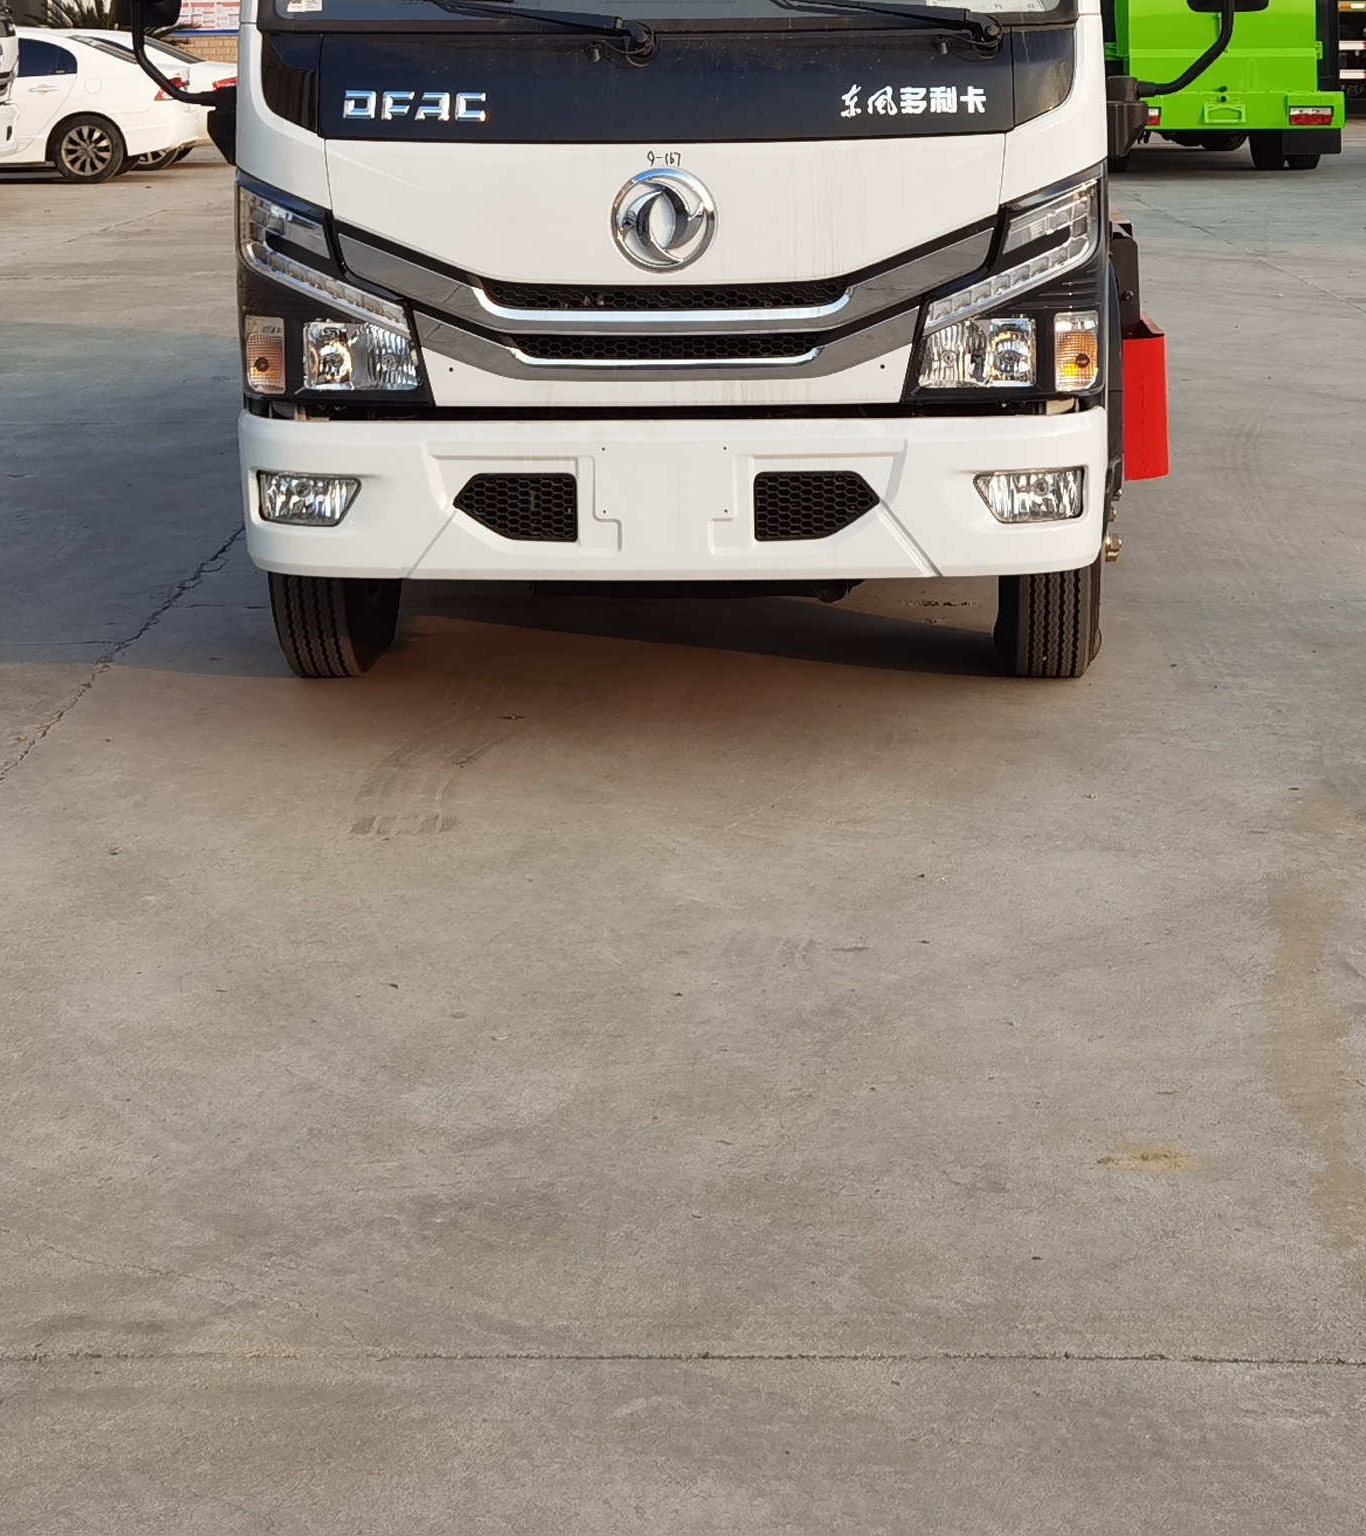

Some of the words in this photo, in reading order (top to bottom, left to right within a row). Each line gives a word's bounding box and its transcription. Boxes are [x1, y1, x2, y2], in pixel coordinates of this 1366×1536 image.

[343, 90, 486, 122] DFAC
[840, 84, 987, 118] 东风多利卡
[647, 150, 681, 167] 9-167
